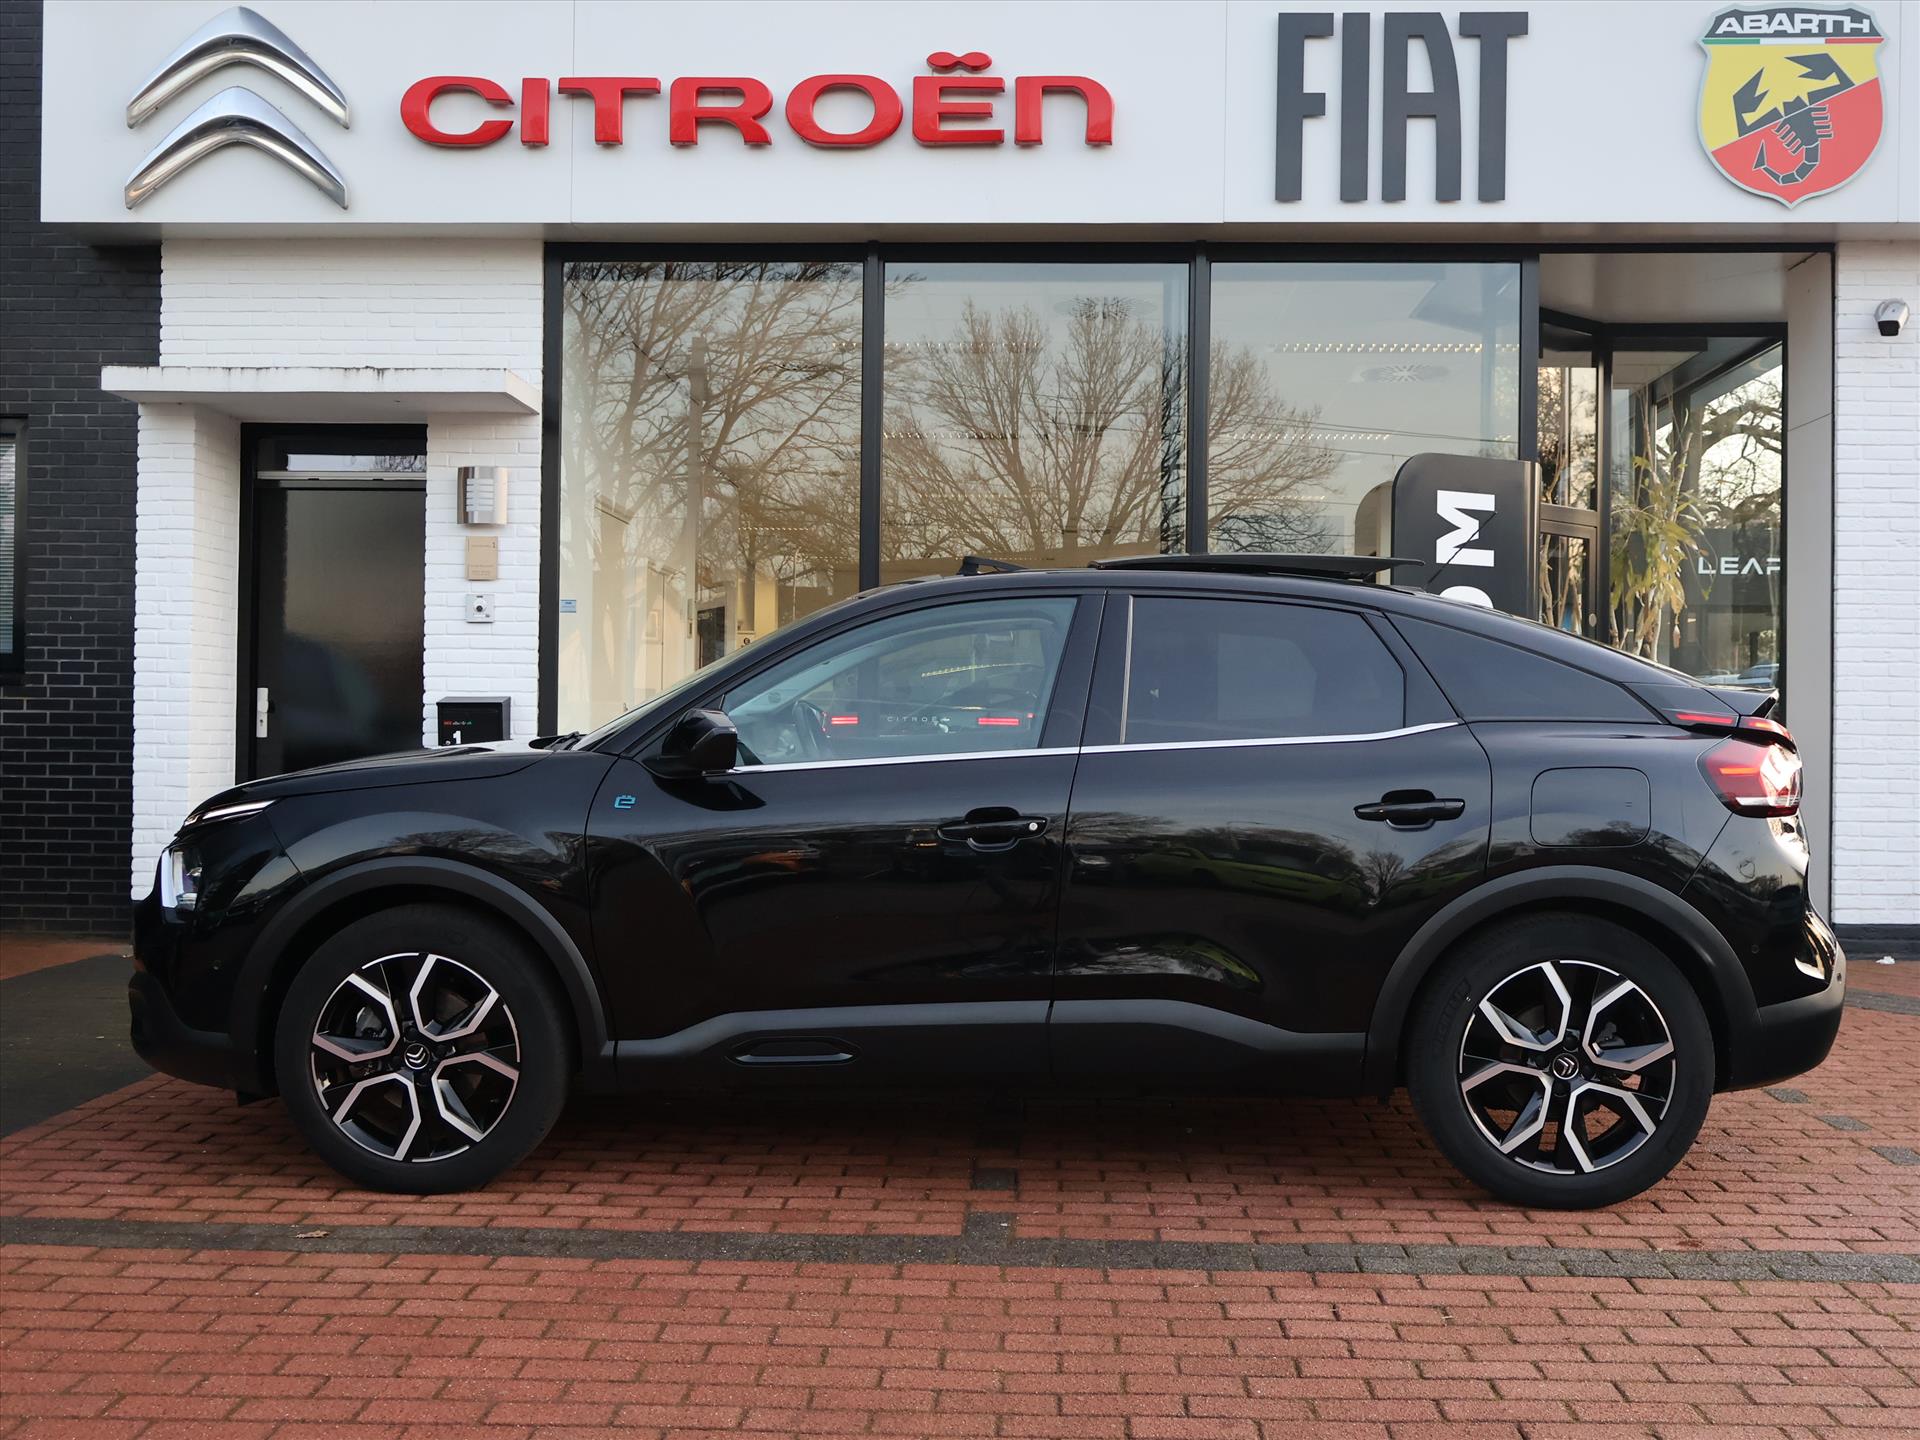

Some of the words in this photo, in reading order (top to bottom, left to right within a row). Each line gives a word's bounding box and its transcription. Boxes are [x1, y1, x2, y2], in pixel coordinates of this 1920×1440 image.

[1715, 13, 1870, 34] ABARTH
[1275, 12, 1529, 204] FIAT
[452, 730, 462, 744] 1
